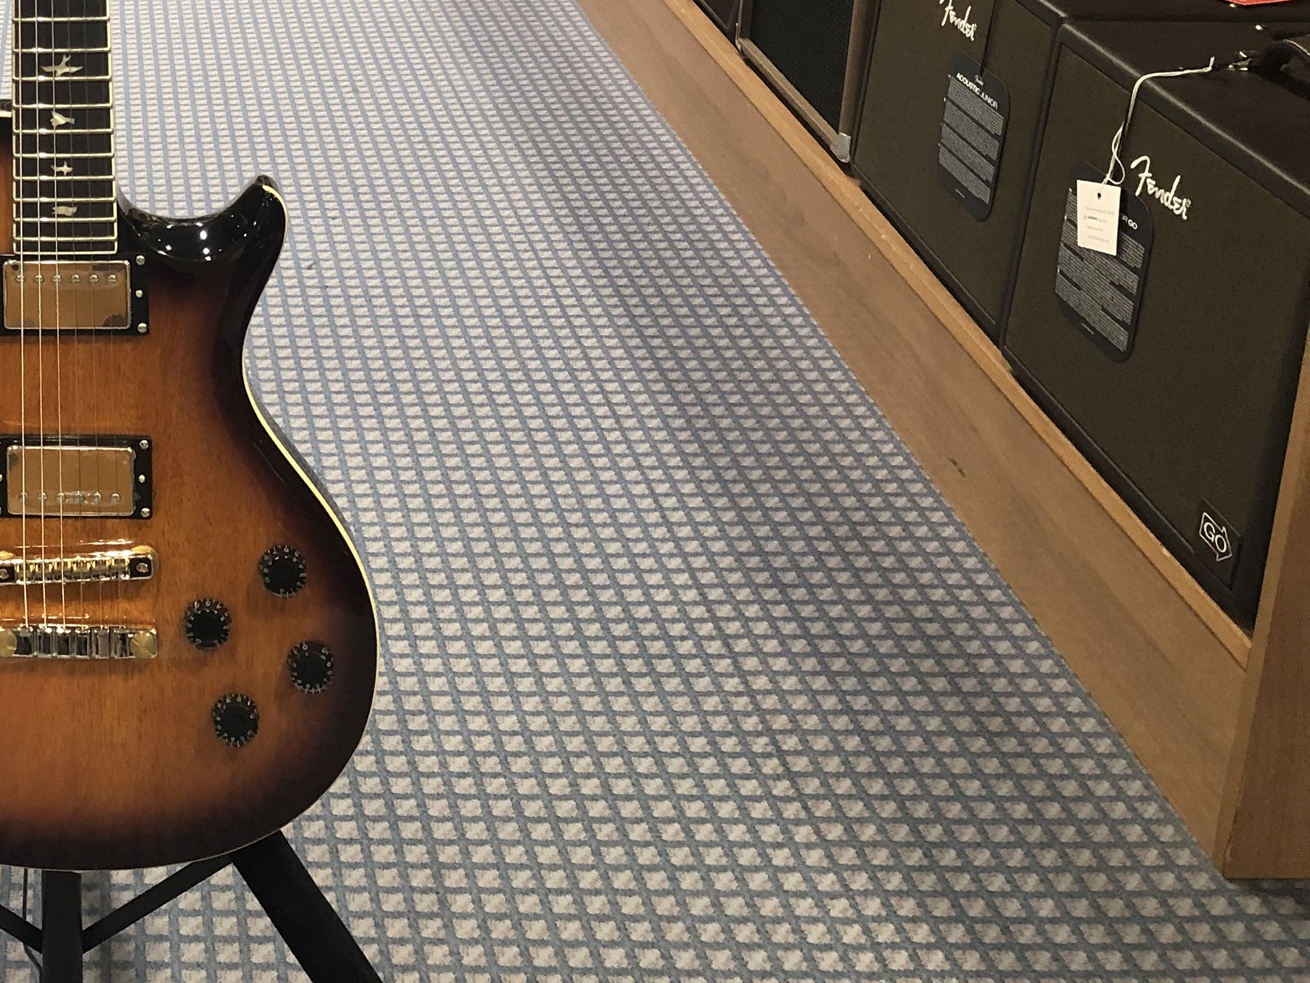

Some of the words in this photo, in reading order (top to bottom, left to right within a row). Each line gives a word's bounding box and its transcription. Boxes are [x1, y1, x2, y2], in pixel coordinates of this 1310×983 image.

[956, 72, 981, 95] ACOUSTIC
[980, 91, 999, 110] JUNIOR
[1130, 155, 1191, 221] Fender
[1203, 522, 1227, 553] GO
